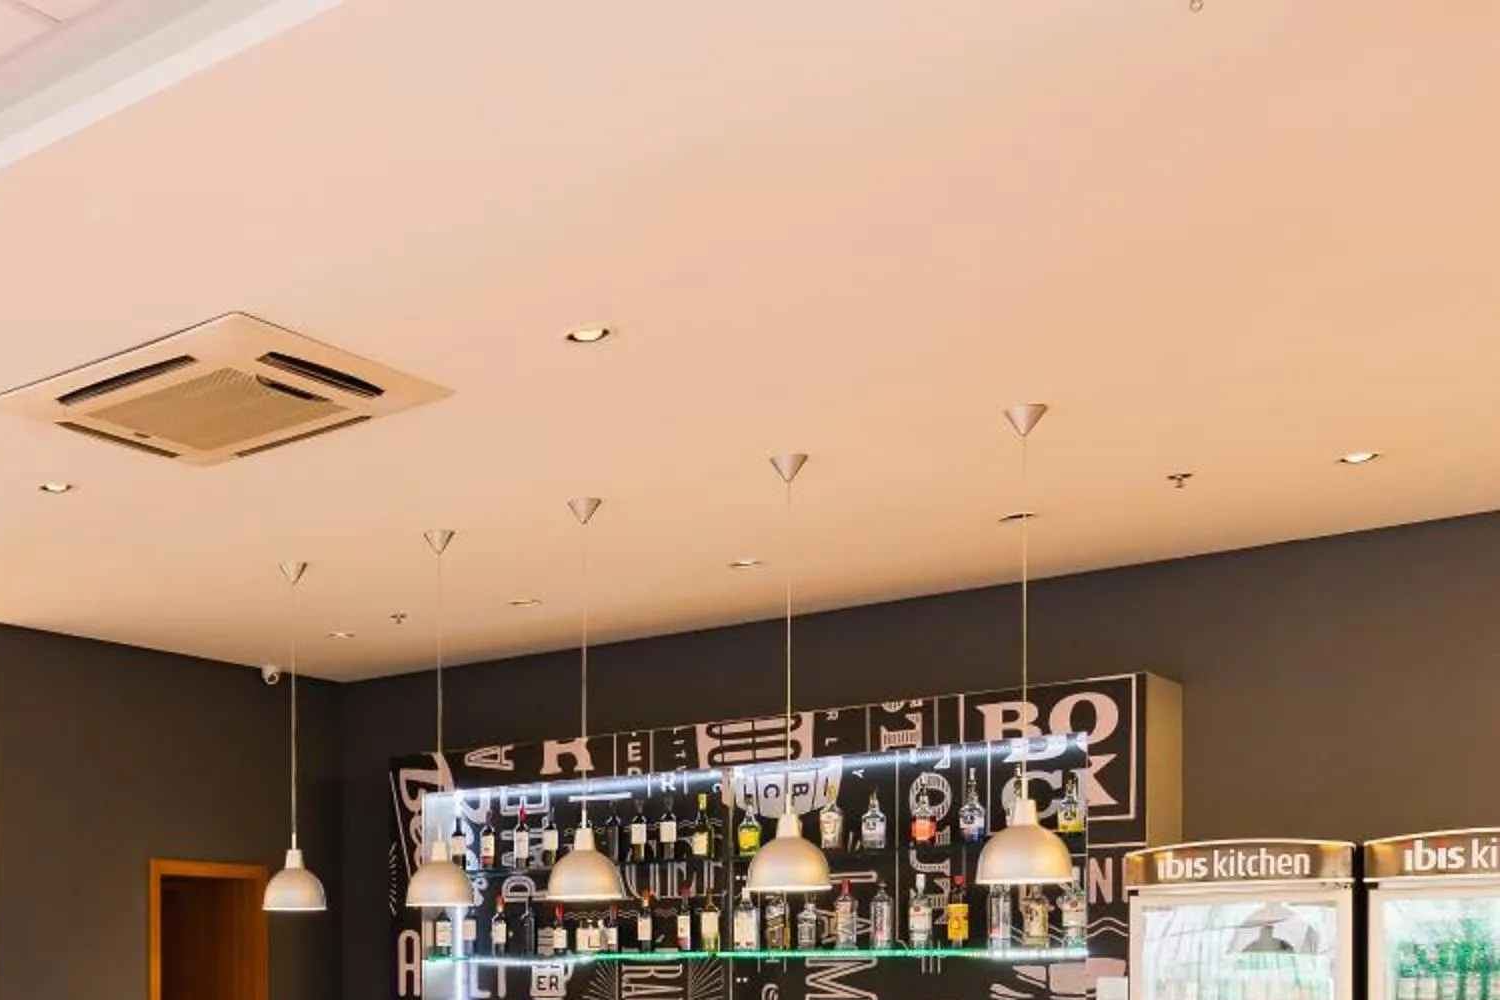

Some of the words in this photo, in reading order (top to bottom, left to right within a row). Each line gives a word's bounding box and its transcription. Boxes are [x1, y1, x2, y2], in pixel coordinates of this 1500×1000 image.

[1157, 850, 1208, 880] ibis
[1213, 848, 1311, 878] kitchen
[1404, 839, 1466, 871] ibis
